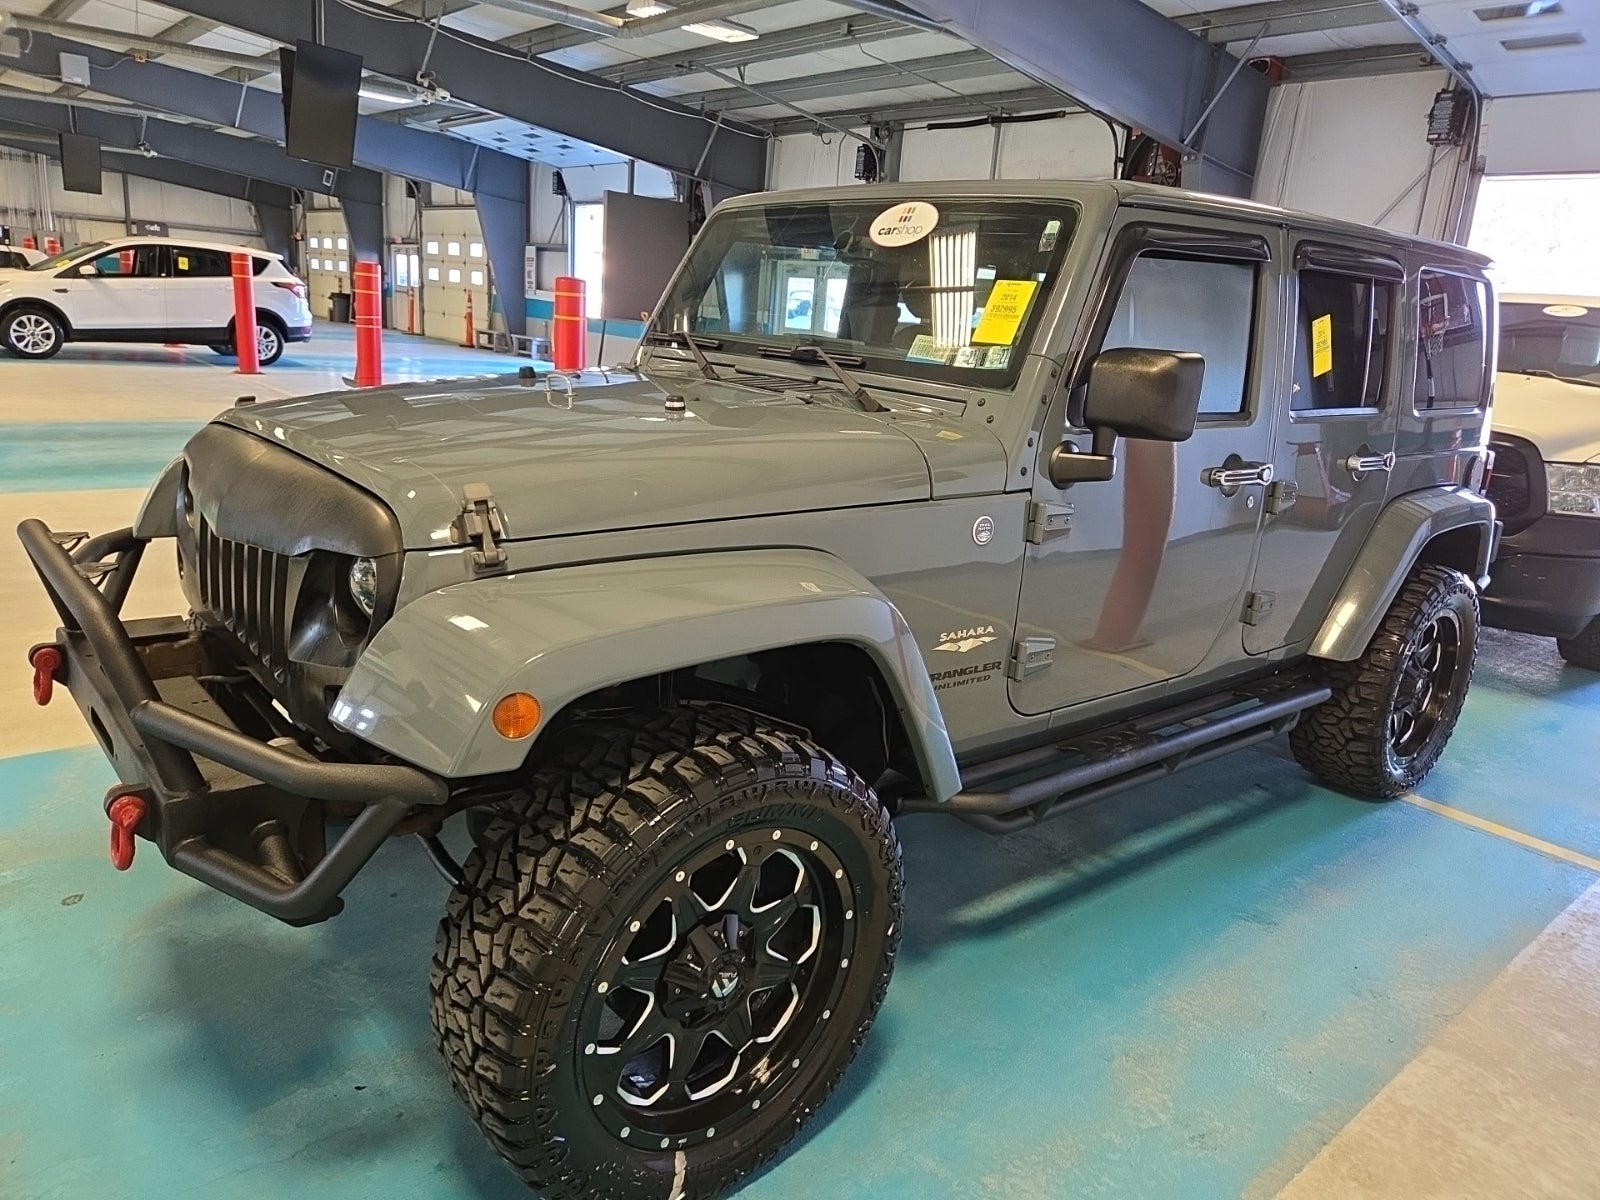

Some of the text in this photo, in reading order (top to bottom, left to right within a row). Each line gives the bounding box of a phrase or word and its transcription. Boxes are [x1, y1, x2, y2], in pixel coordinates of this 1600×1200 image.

[877, 225, 923, 238] carshop
[939, 625, 994, 642] SAHARA
[929, 660, 1002, 682] RANGLER
